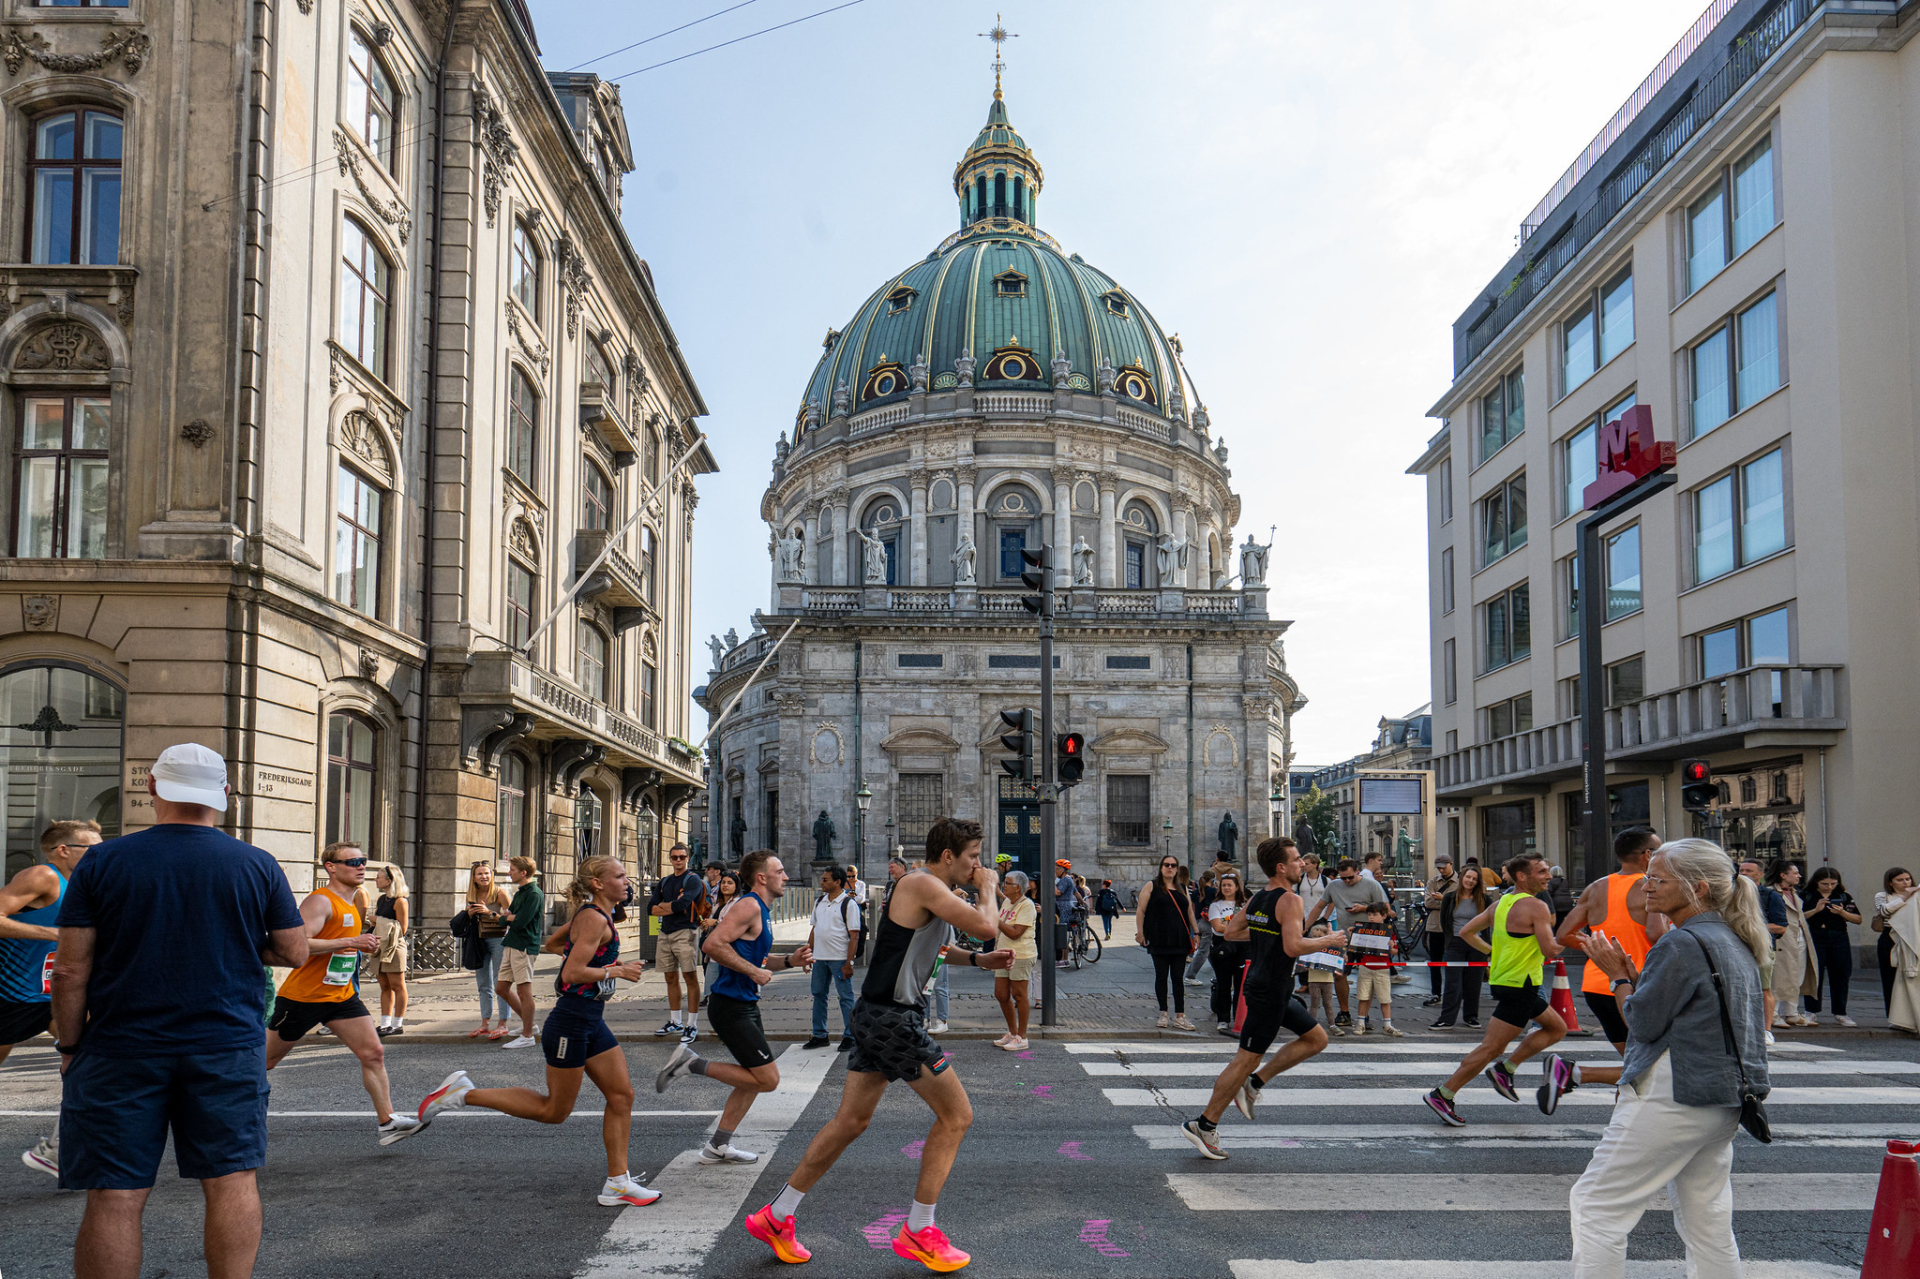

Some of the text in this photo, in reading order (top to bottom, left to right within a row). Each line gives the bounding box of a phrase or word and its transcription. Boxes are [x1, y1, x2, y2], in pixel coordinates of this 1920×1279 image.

[1584, 405, 1665, 510] M
[131, 766, 151, 775] STO
[258, 771, 313, 787] FREDERIKSGADE
[257, 782, 273, 792] 1-13
